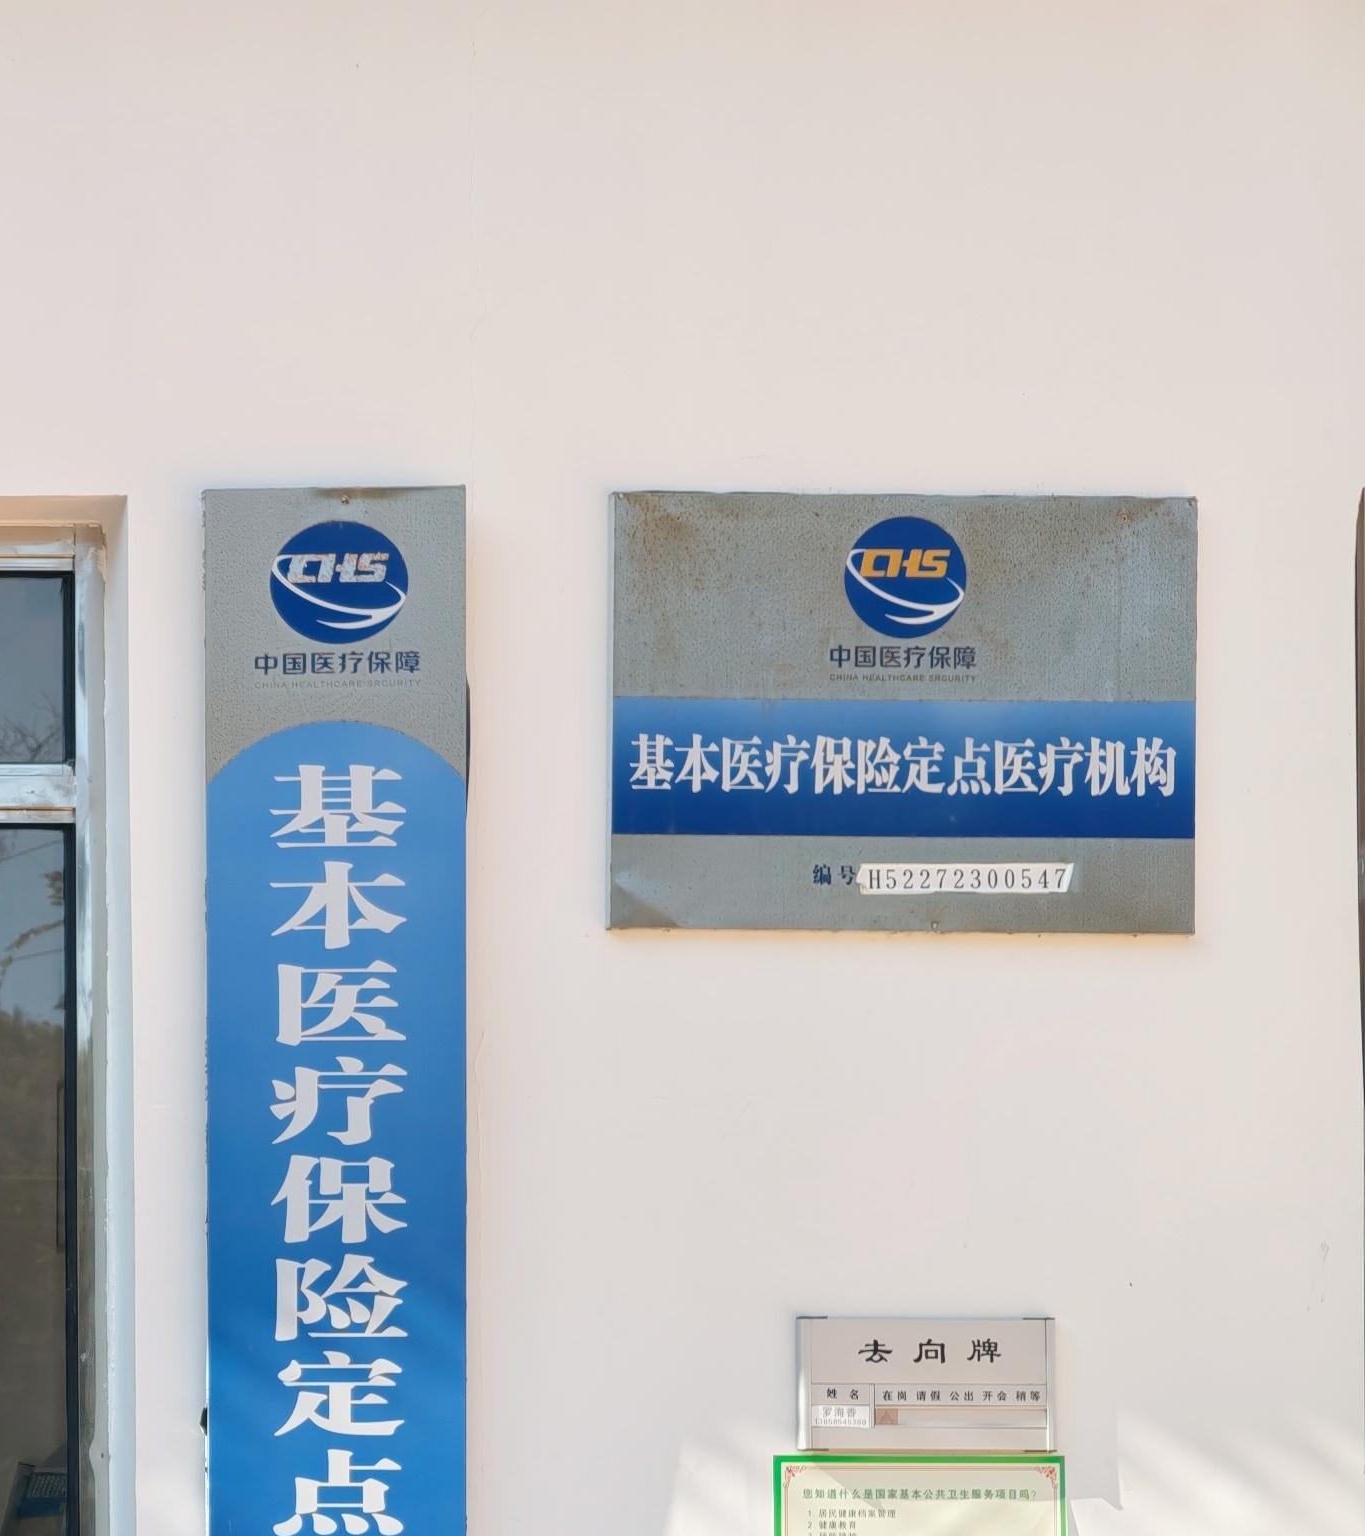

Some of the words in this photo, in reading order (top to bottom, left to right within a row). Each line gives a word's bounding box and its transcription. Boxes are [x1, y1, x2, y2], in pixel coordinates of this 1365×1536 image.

[859, 546, 951, 579] CHS
[254, 650, 421, 675] 中国医疗保障
[829, 644, 977, 671] 中国医疗保障
[630, 732, 1177, 797] 基本医疗保险定点医疗机构
[812, 863, 855, 885] 编号
[868, 867, 1068, 891] H52272300547
[858, 1338, 1002, 1364] 去向牌
[826, 1388, 860, 1400] 姓名
[916, 1389, 941, 1401] 请假
[950, 1389, 974, 1401] 公出
[982, 1389, 1008, 1401] 开会
